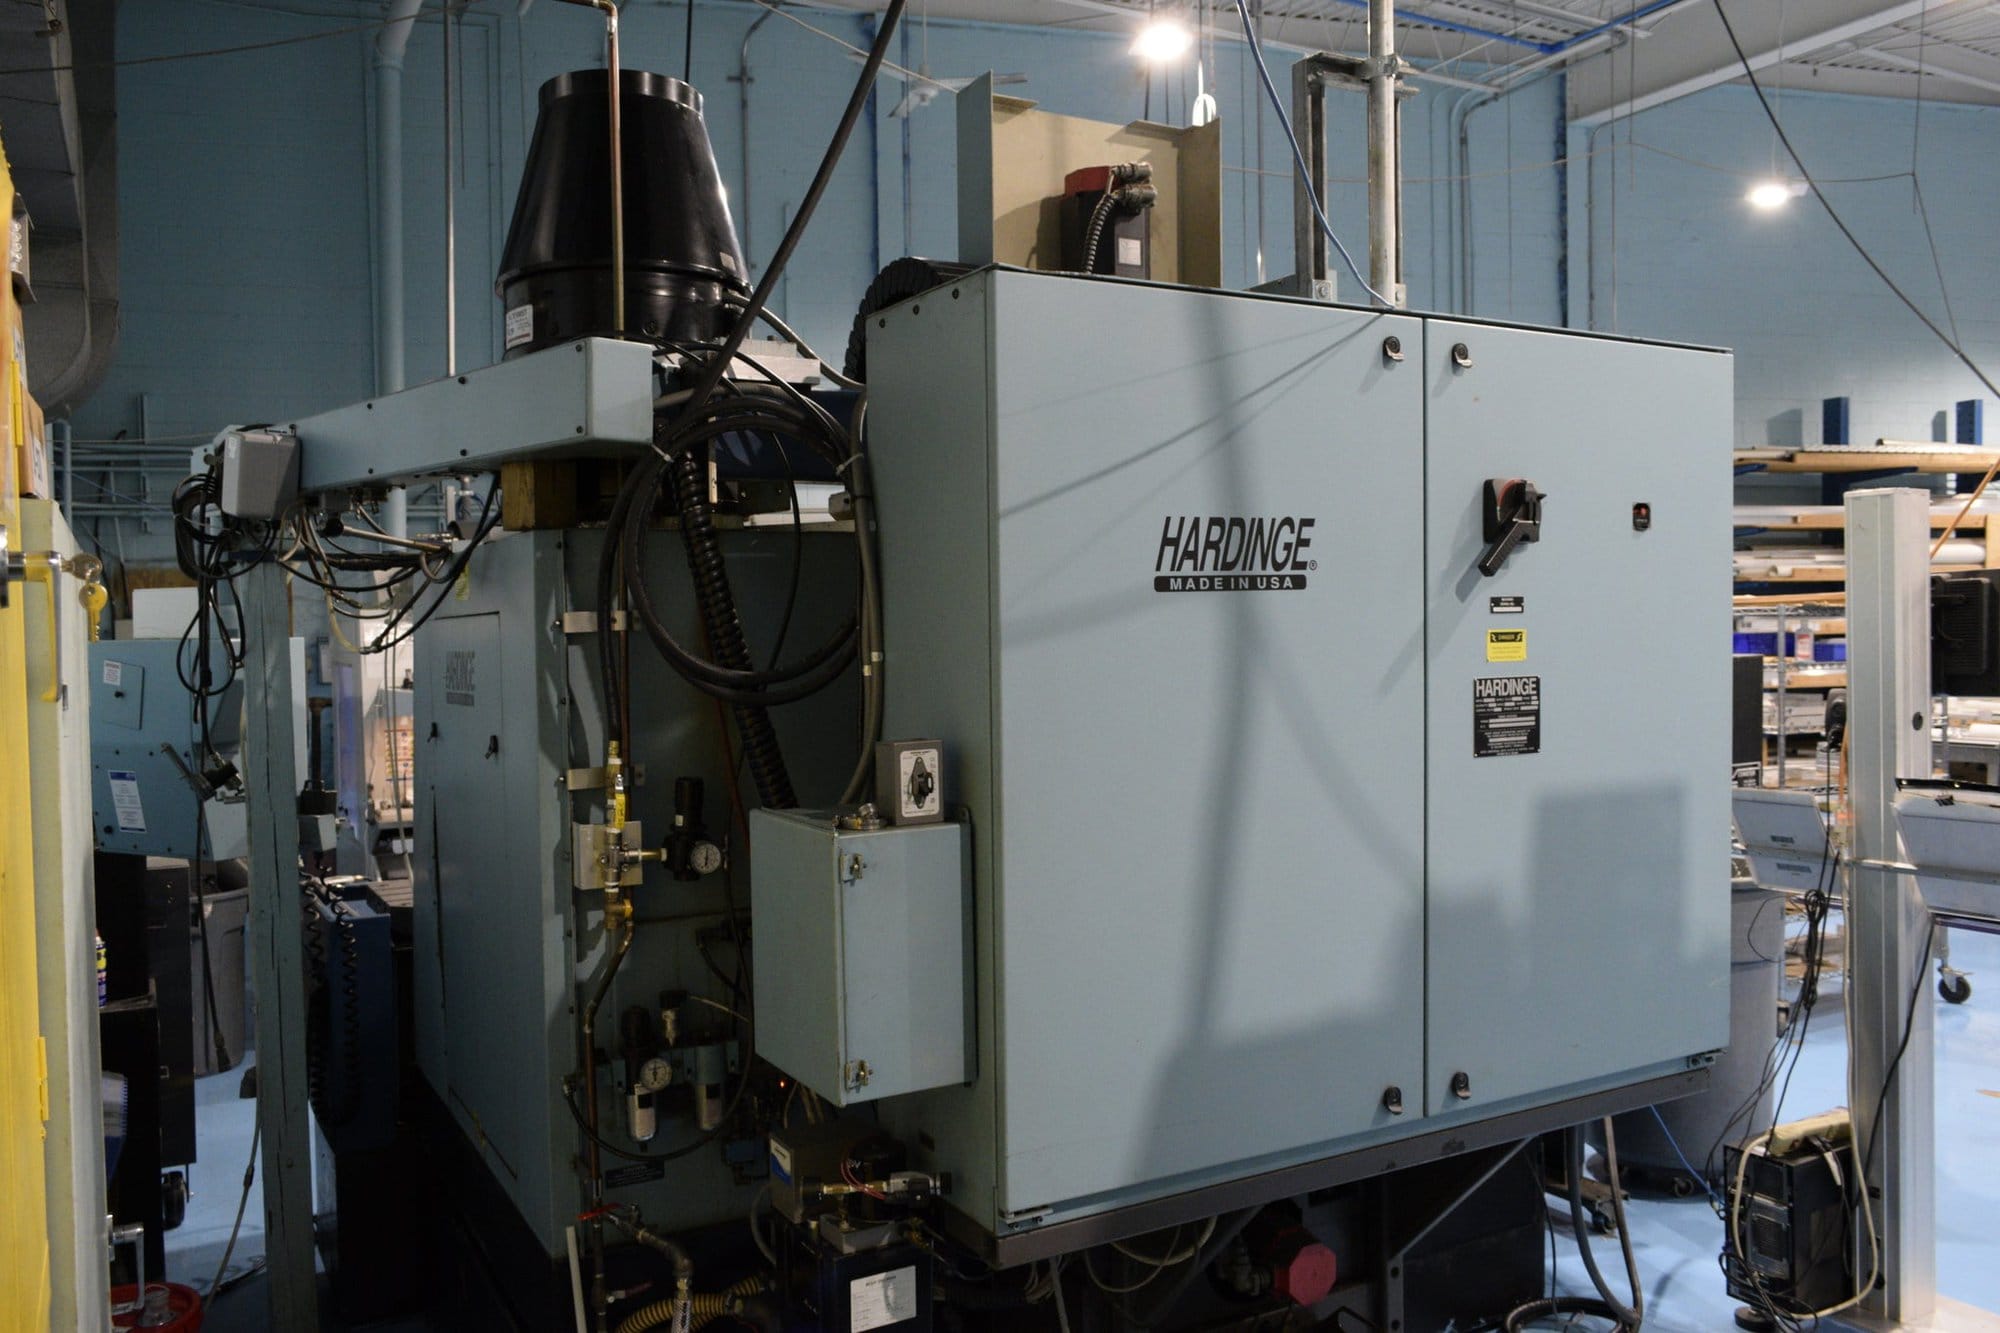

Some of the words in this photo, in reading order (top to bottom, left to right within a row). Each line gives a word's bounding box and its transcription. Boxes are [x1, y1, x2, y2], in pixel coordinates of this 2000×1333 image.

[1169, 577, 1224, 590] MADE
[1231, 577, 1249, 589] IN
[1256, 576, 1294, 589] USA
[1476, 677, 1537, 697] HARDINGE
